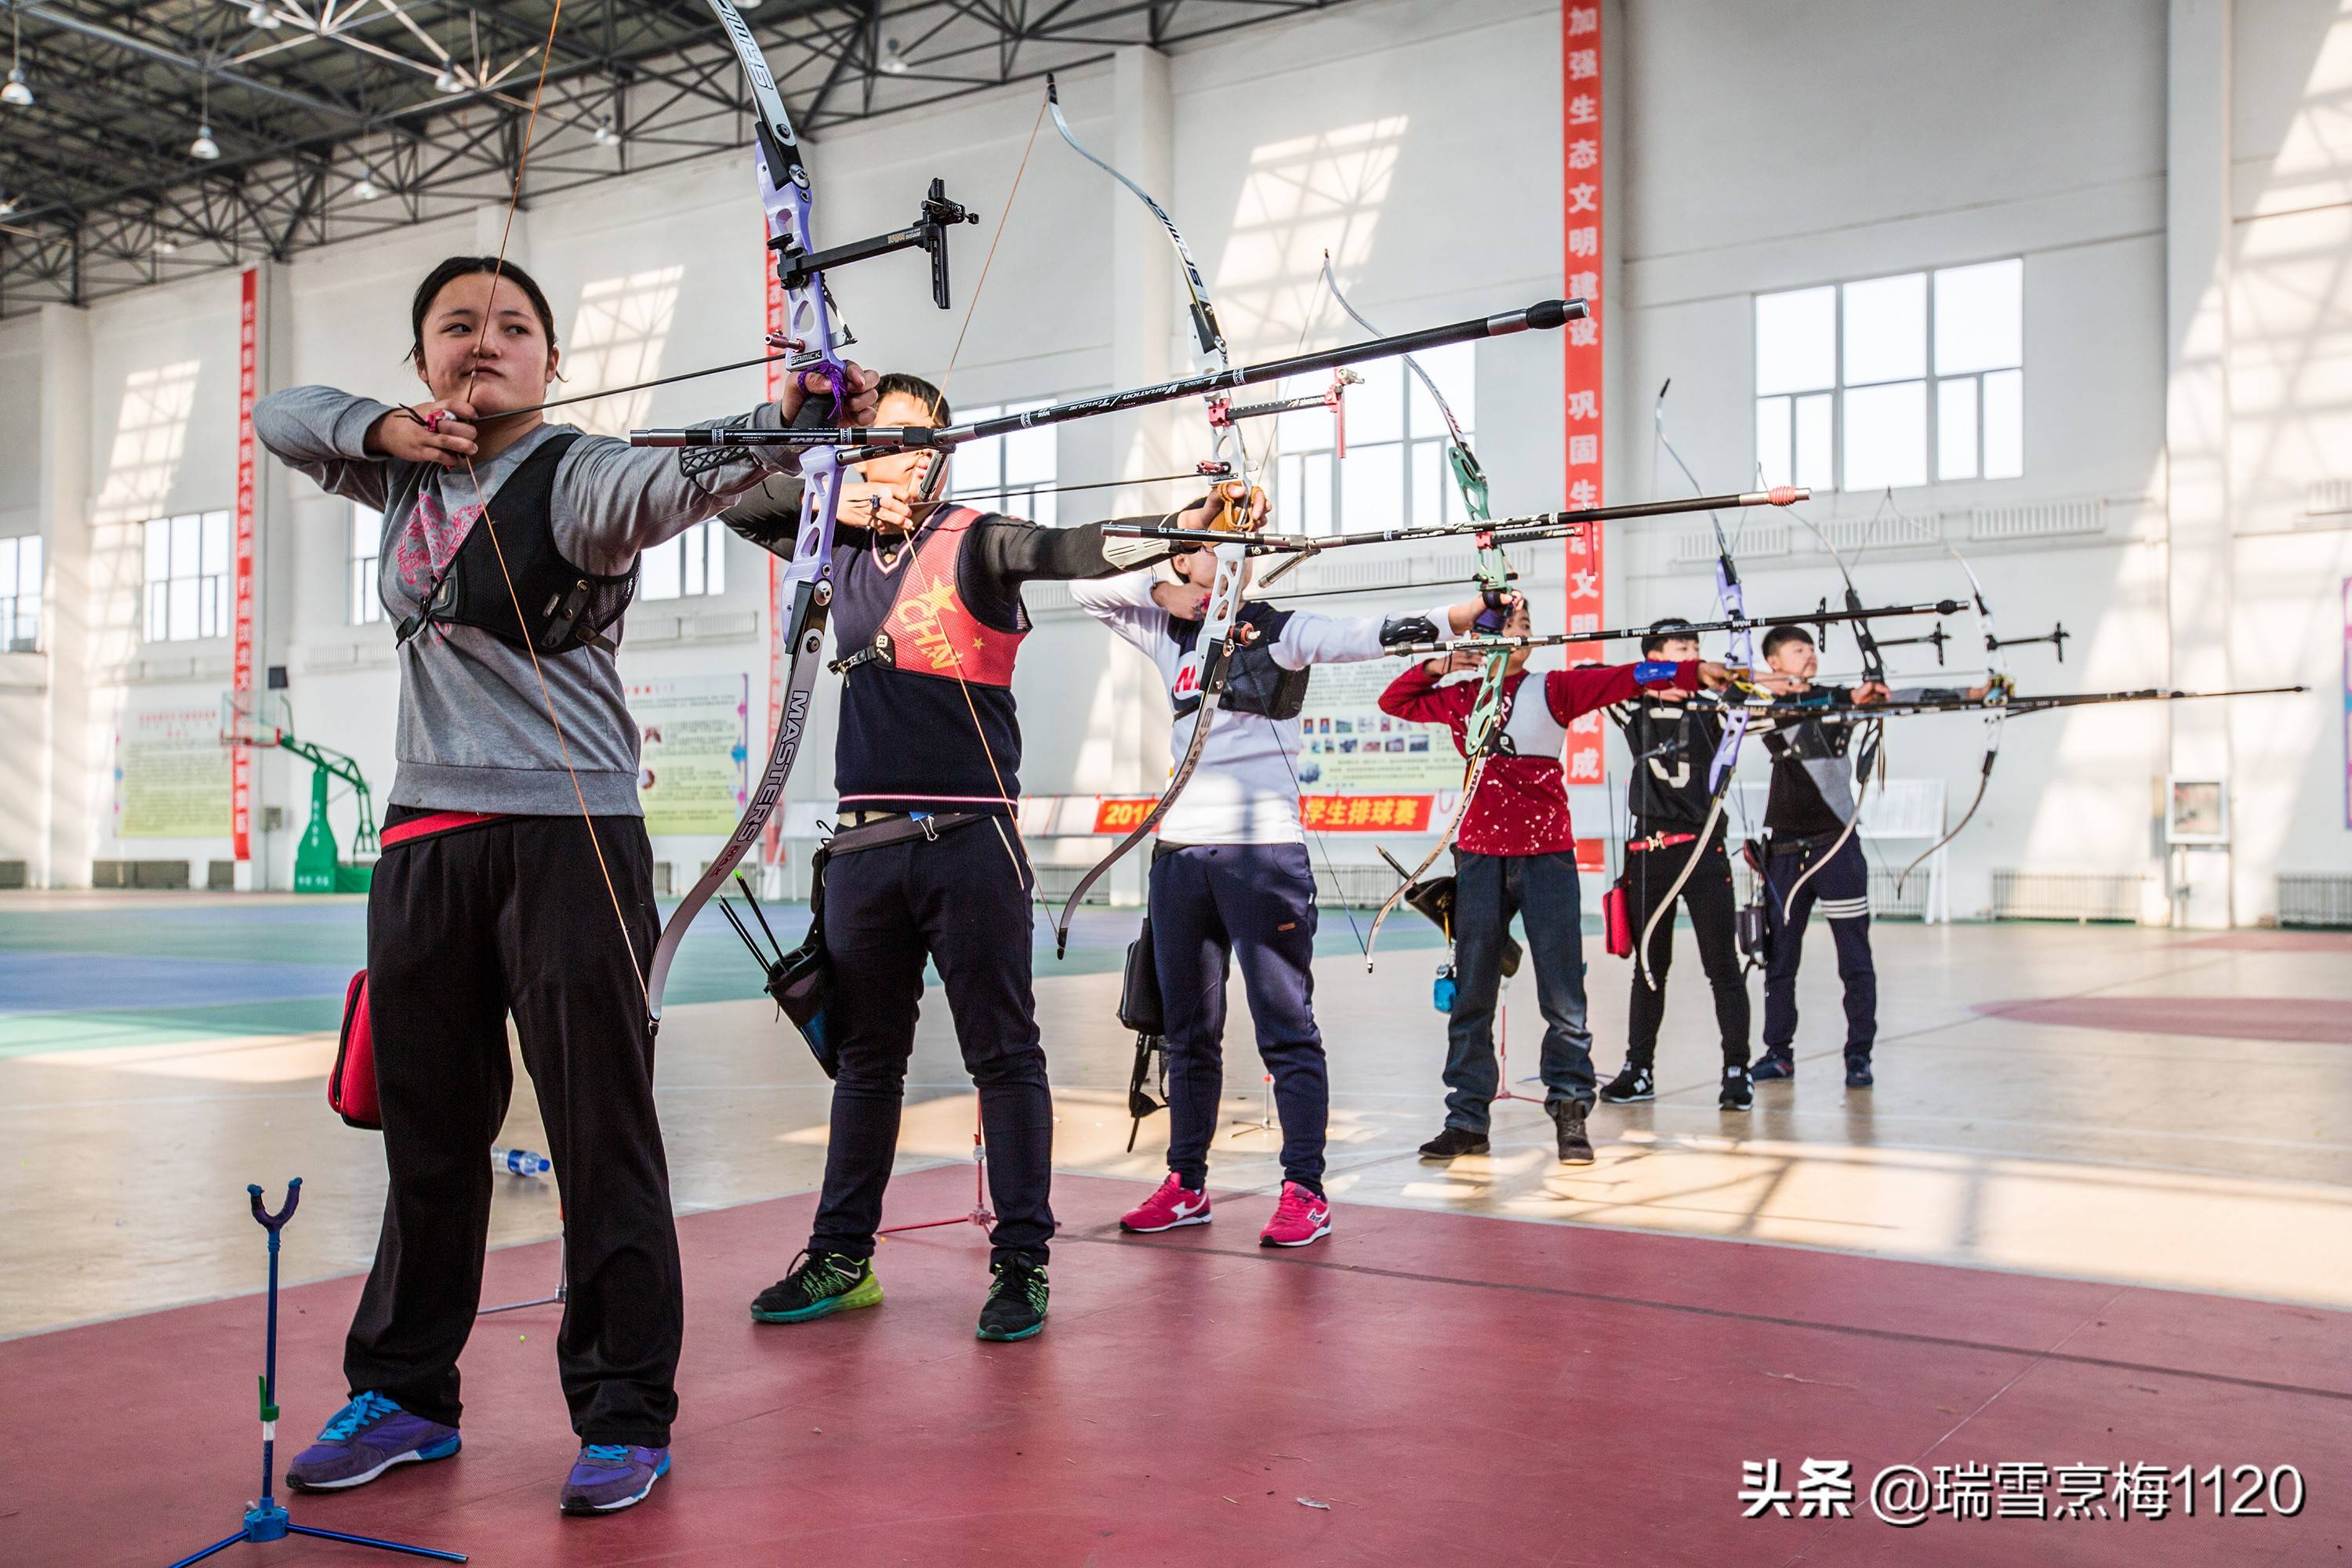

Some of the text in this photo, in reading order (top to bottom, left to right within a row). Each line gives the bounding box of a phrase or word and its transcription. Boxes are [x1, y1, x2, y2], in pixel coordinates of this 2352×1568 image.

[1568, 7, 1599, 347] 加强生态文明建设
[790, 350, 821, 365] SAMICK
[746, 689, 809, 843] MASTERS
[1299, 798, 1418, 826] 学生排球赛
[710, 844, 742, 878] MAX
